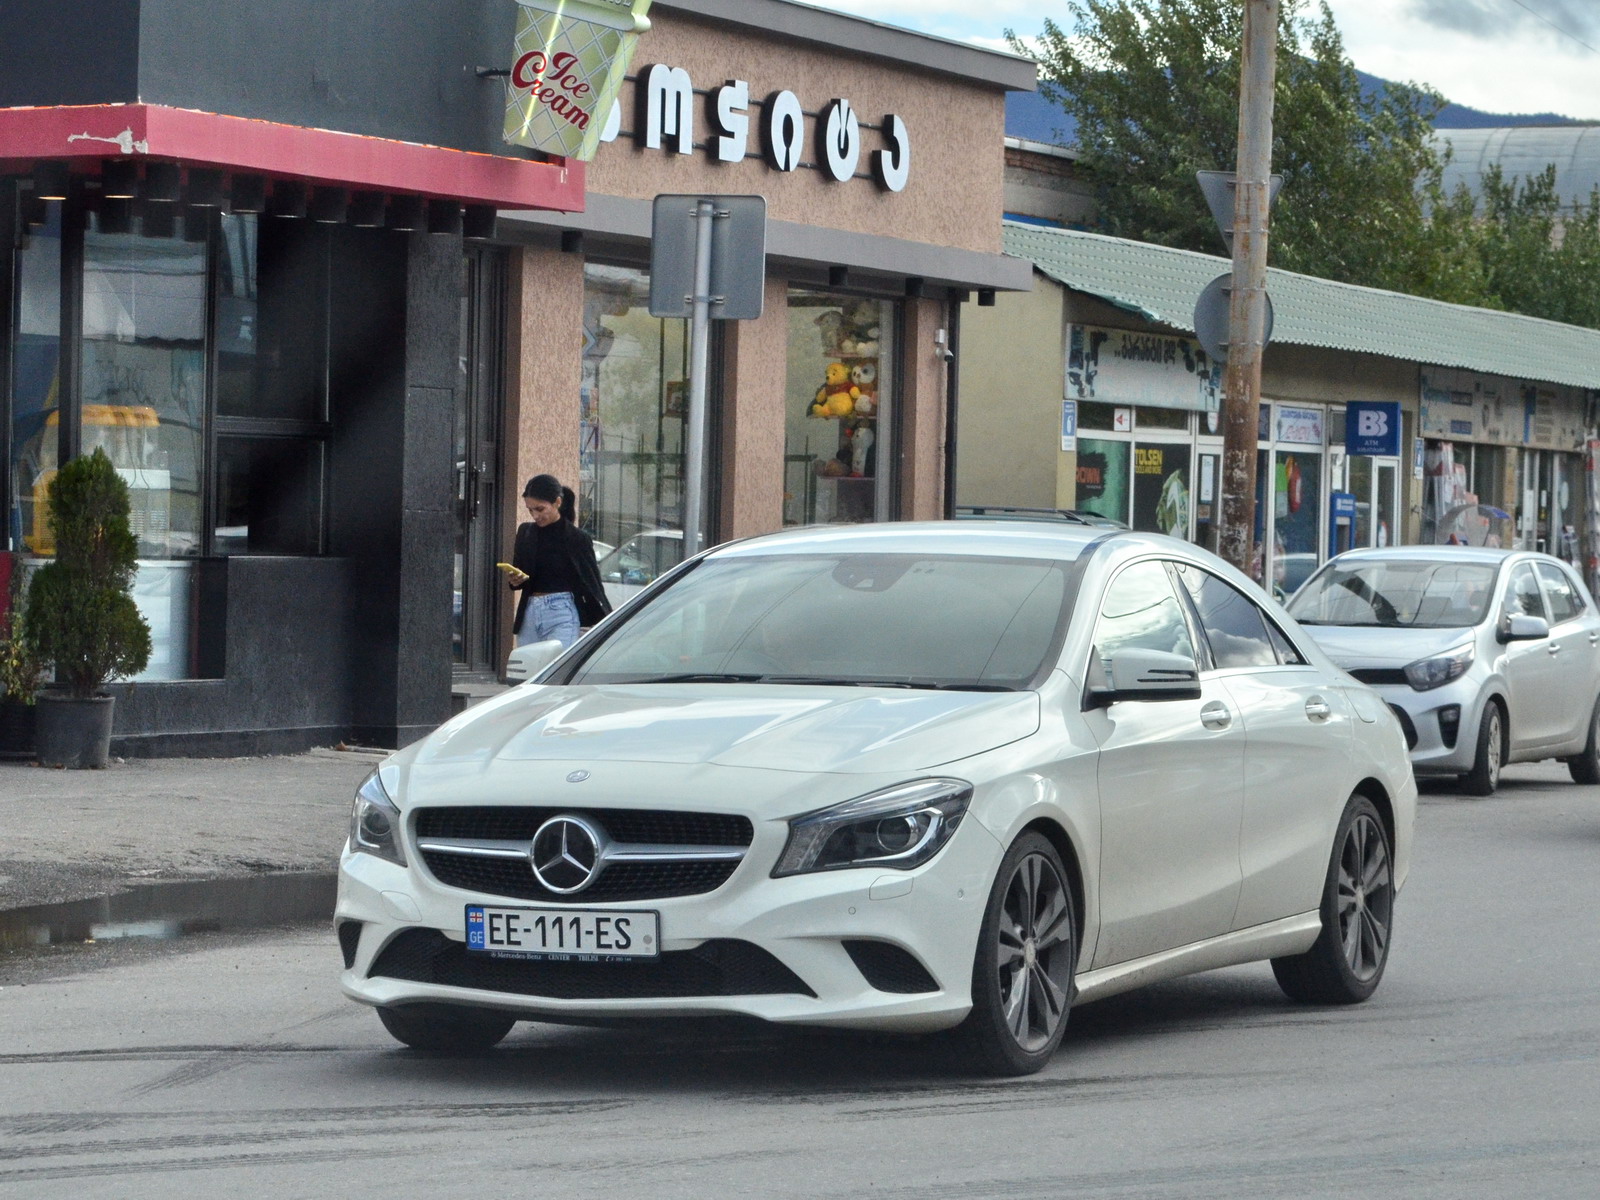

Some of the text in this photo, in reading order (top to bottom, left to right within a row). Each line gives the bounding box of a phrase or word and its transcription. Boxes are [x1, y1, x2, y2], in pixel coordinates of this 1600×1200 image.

[546, 51, 590, 99] Ice
[511, 50, 590, 131] Cream
[600, 63, 910, 193] ოჯინა
[1135, 448, 1163, 466] TOLSEN
[1364, 439, 1379, 447] ATM
[469, 930, 484, 945] GE
[488, 912, 632, 950] EE-111-ES
[497, 952, 542, 961] Mercedes-Benz
